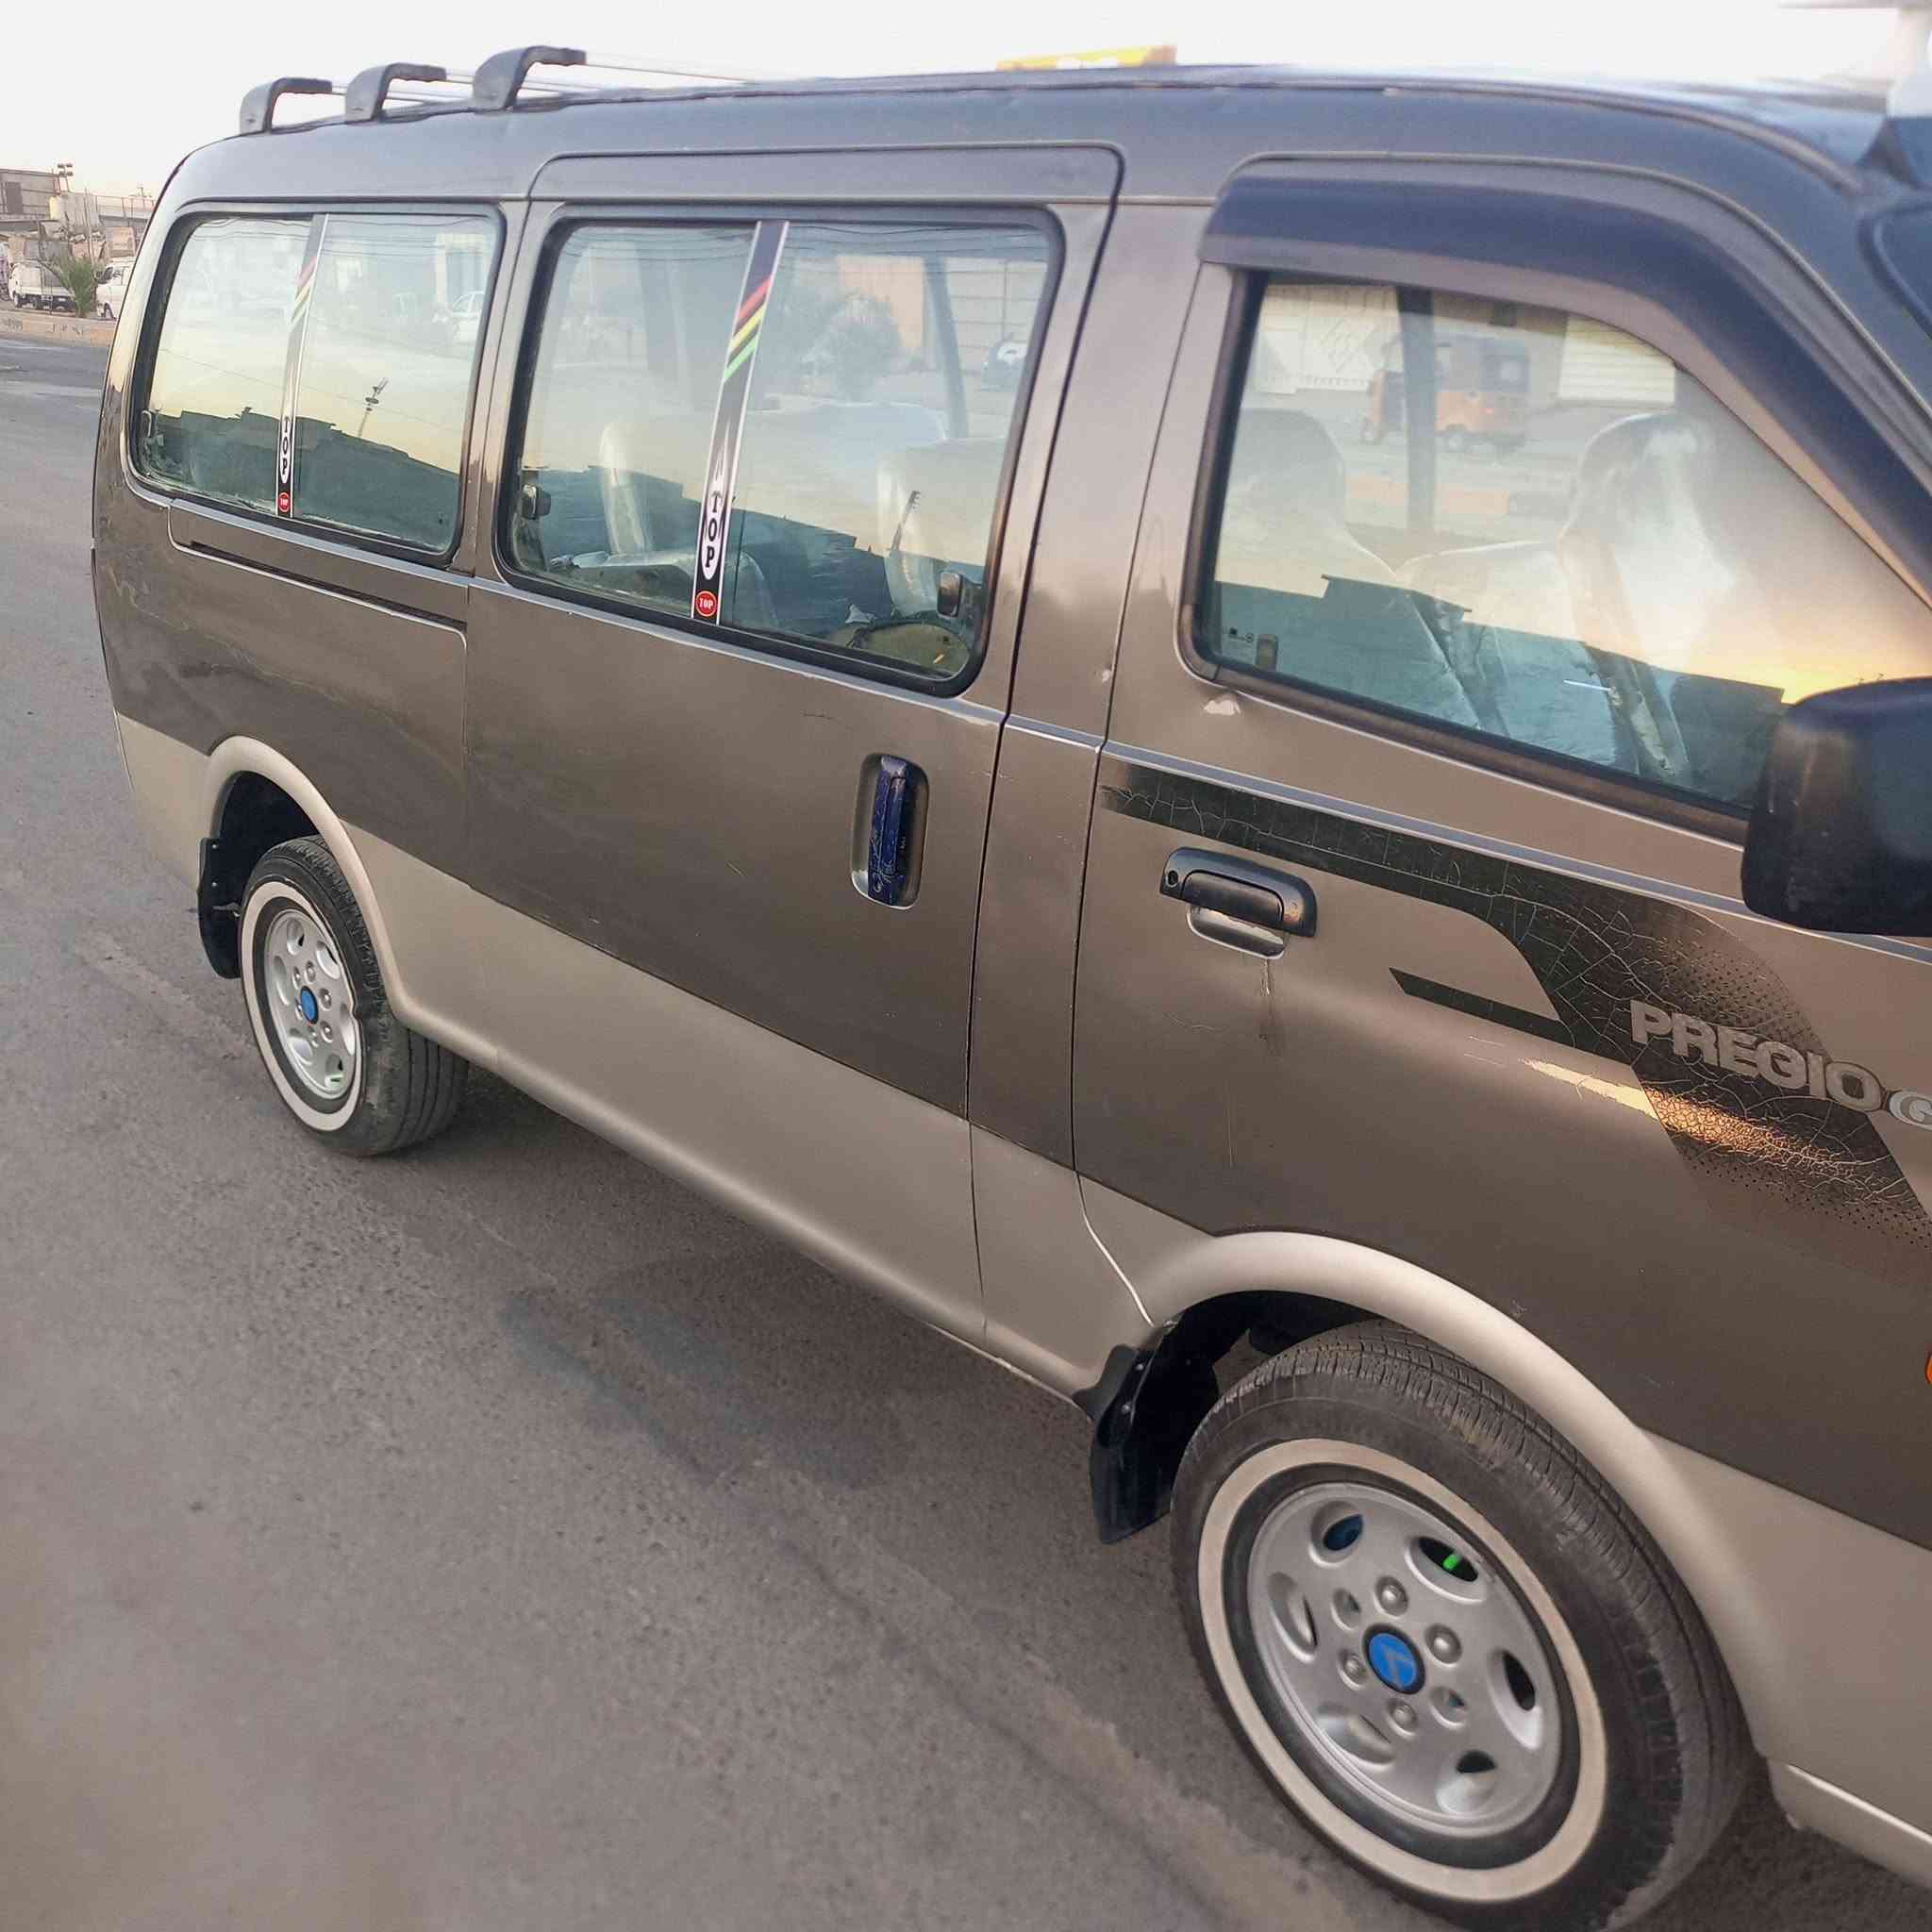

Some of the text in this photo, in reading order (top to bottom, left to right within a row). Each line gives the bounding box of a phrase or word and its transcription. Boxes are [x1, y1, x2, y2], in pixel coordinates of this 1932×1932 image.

[281, 416, 290, 475] TOP
[705, 491, 722, 568] TOP
[699, 597, 714, 609] TOP
[1630, 999, 1884, 1111] PREGIO
